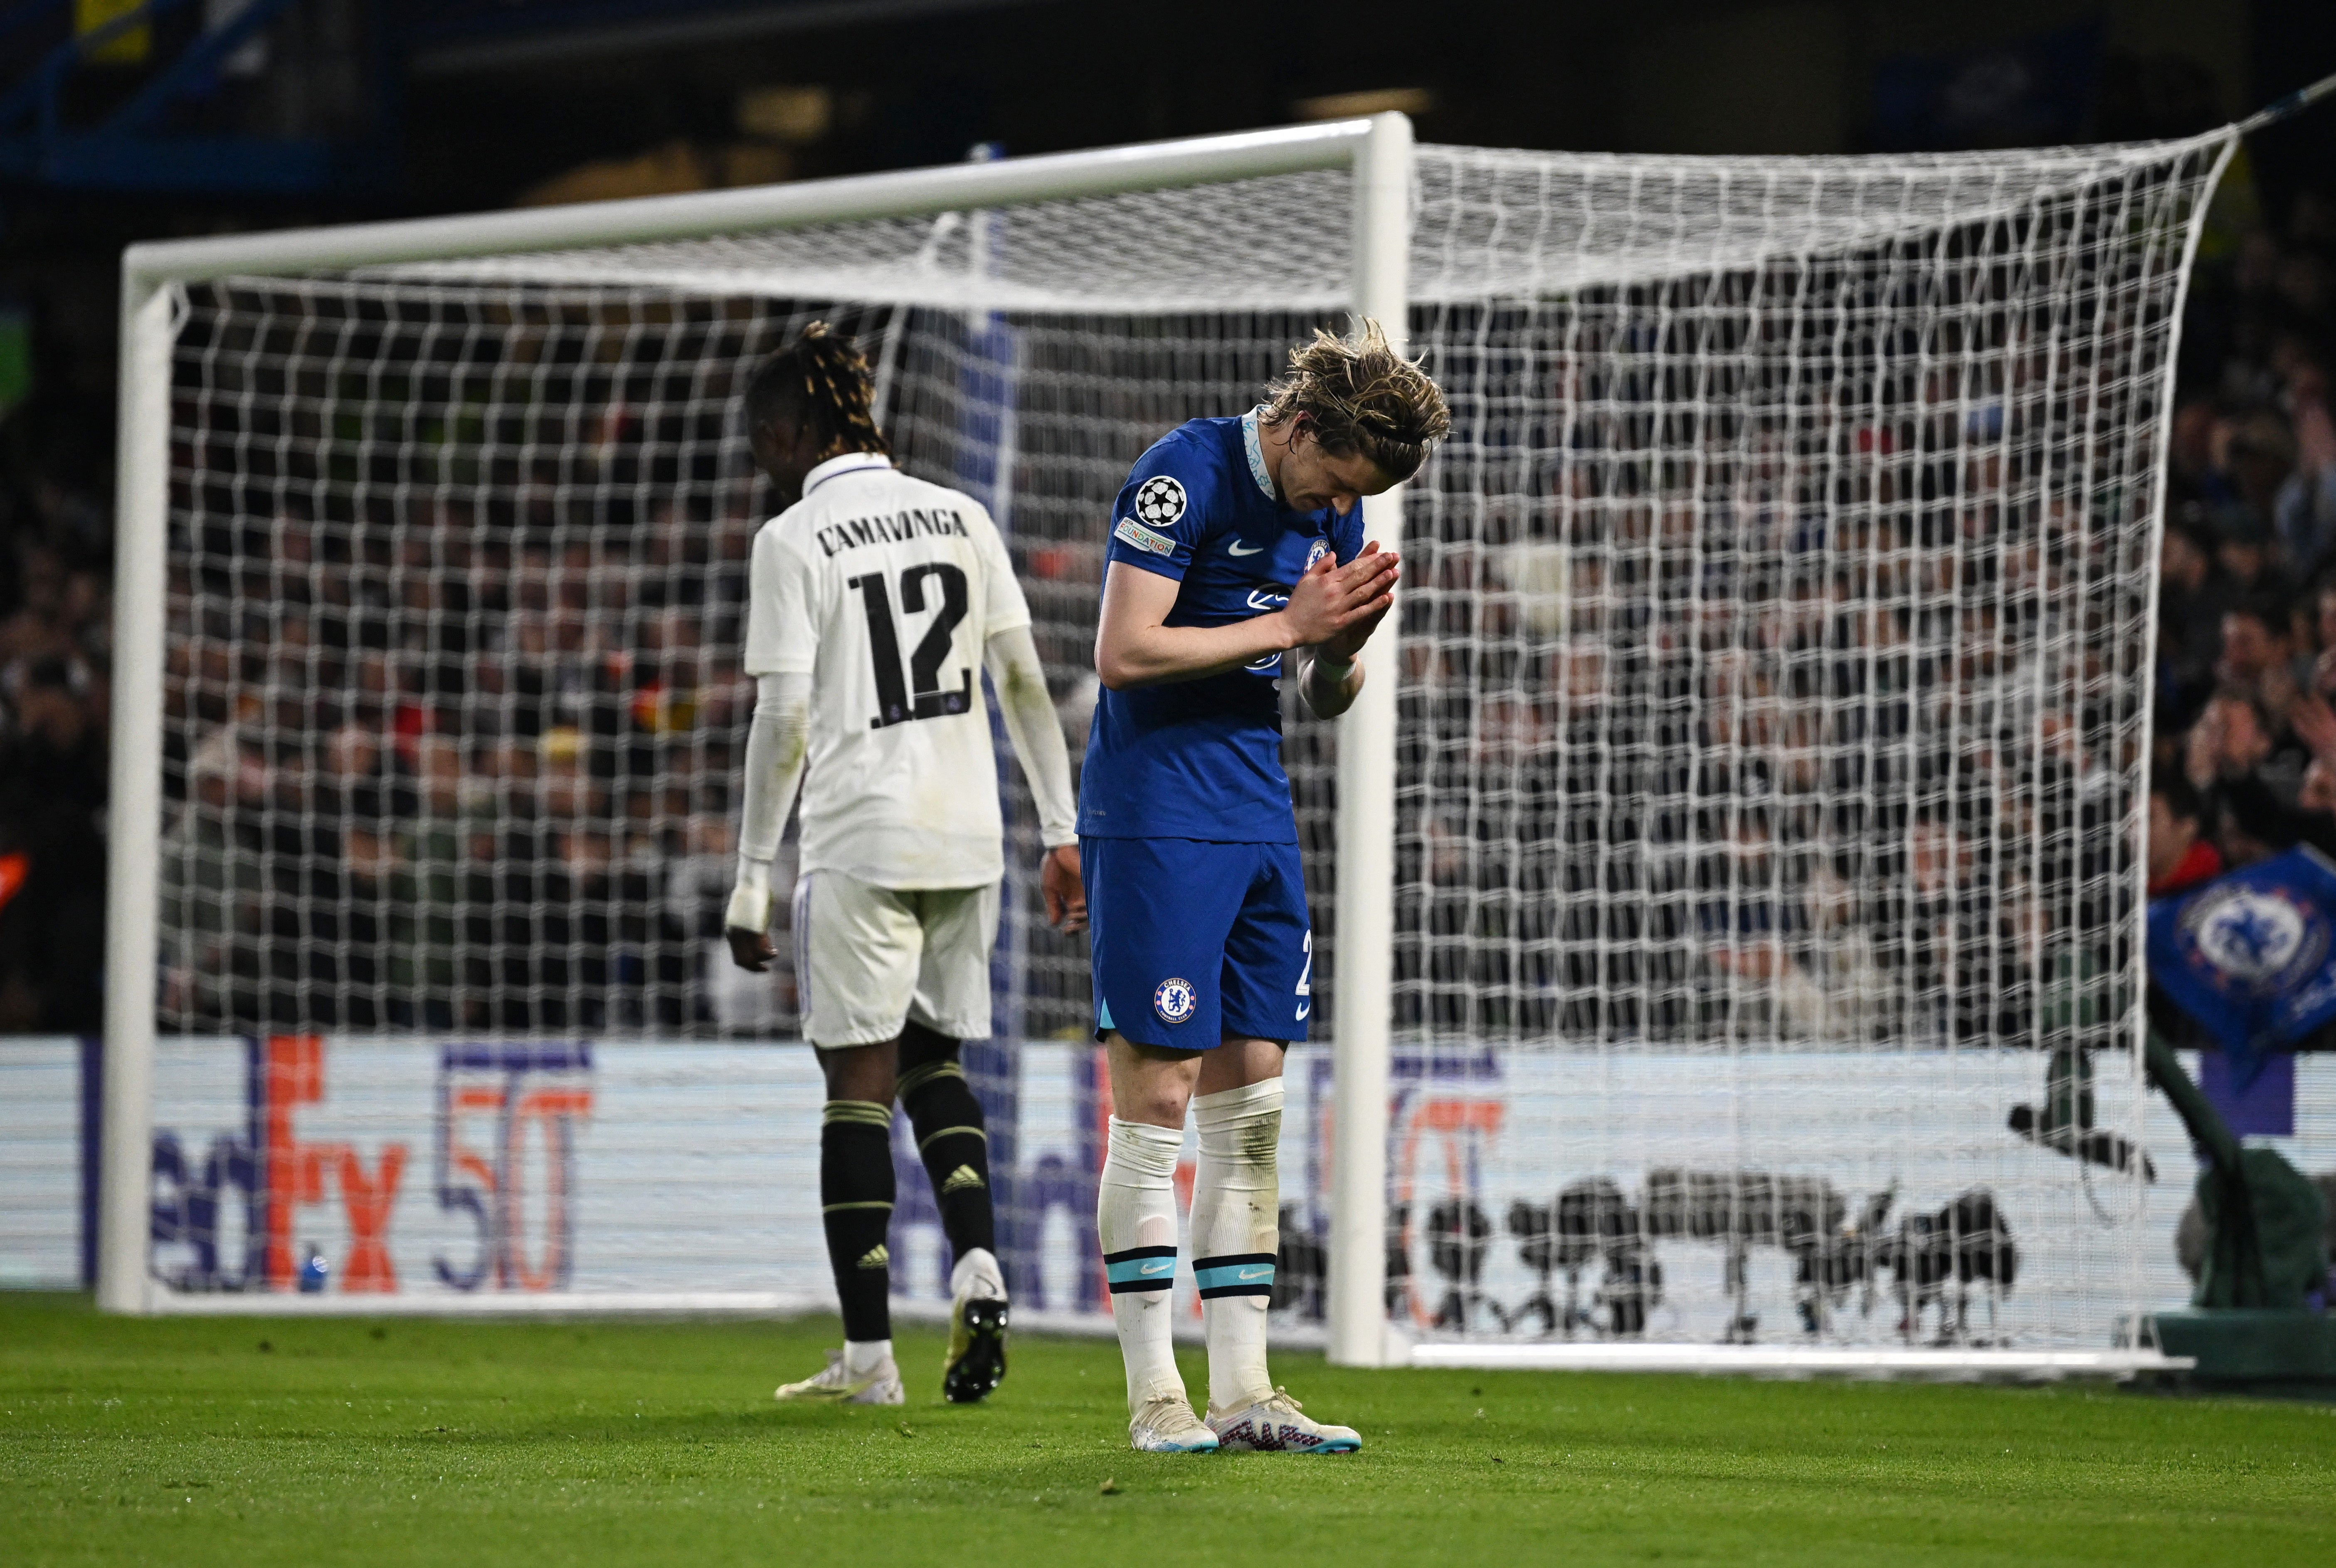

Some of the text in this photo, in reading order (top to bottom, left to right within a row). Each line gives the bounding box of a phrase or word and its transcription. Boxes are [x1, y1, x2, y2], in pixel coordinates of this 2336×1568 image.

[817, 508, 968, 557] CAMAVINGA
[1118, 523, 1172, 554] FOUNDATION
[848, 562, 972, 730] 12
[1164, 979, 1191, 992] CHELSEA
[1160, 1010, 1177, 1021] FOOTBALL
